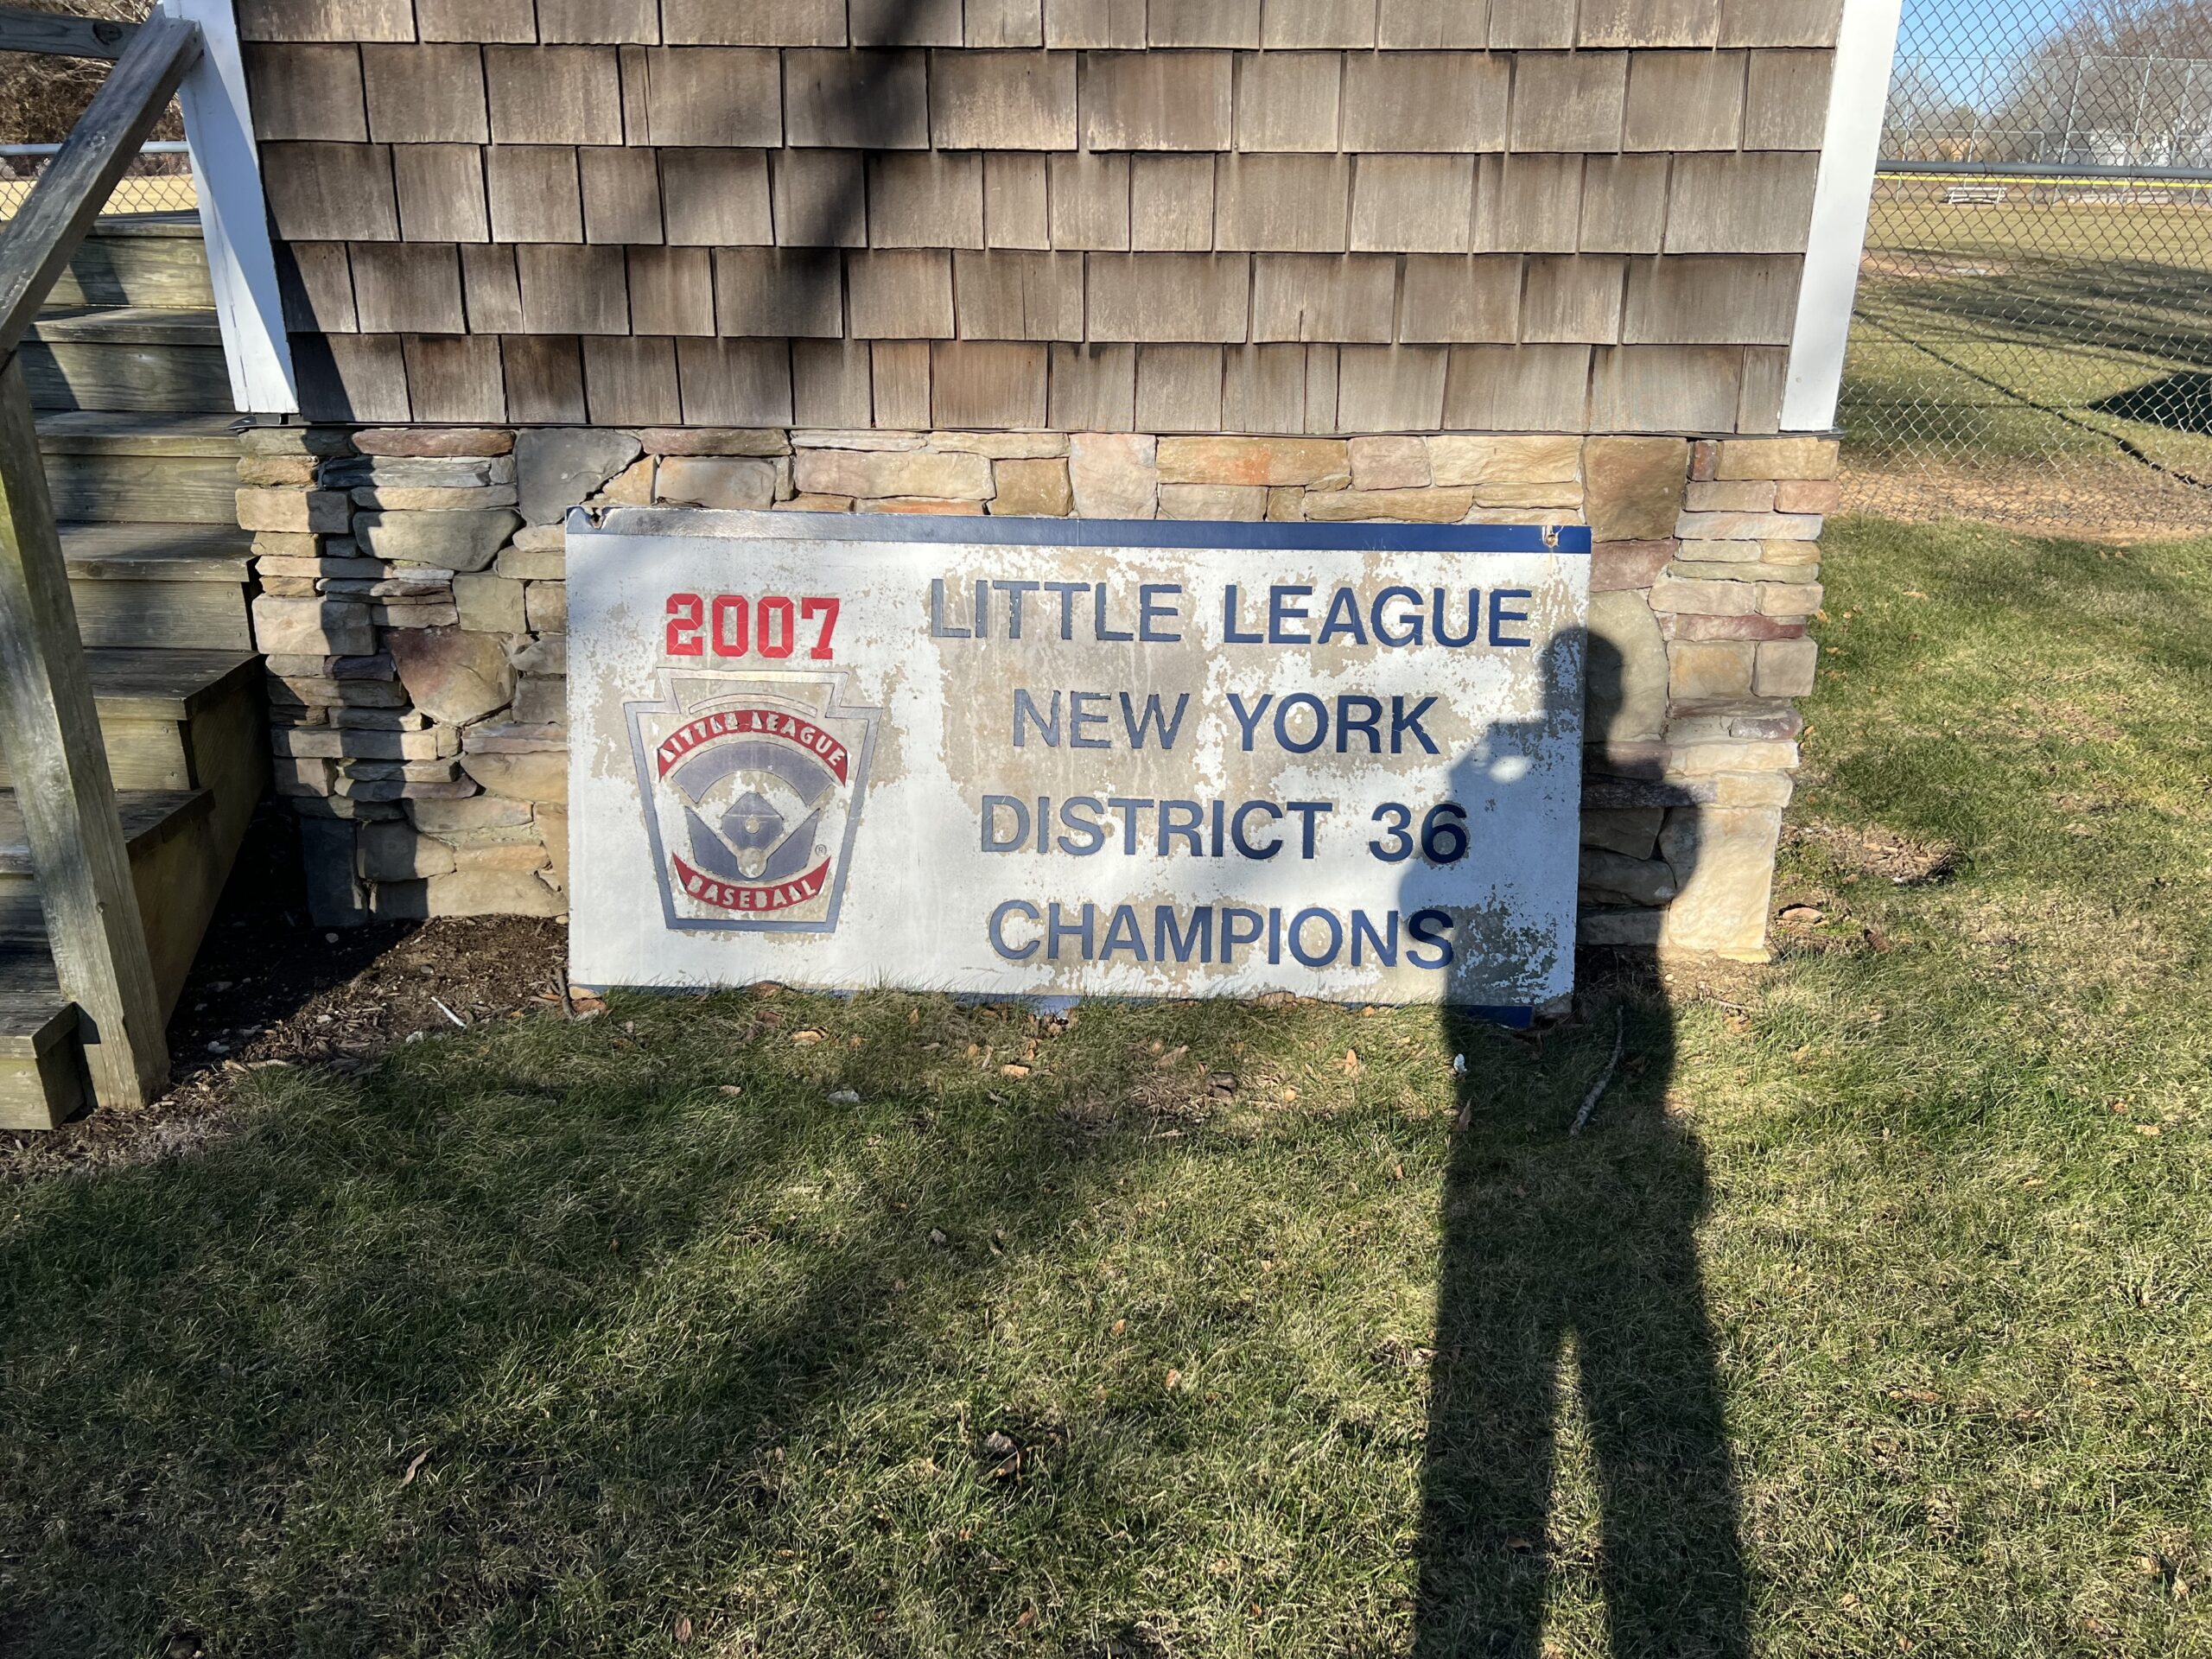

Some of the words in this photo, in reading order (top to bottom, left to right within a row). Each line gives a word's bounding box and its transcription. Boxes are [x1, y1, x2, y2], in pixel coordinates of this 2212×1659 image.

[666, 593, 840, 660] 2007
[930, 578, 1182, 643] LITTLE
[1224, 584, 1532, 647] LEAGUE
[750, 710, 848, 766] LEAGUE
[1013, 688, 1191, 750] NEW
[1226, 693, 1440, 754] YORK
[981, 795, 1332, 861] DISTRICT
[1369, 802, 1470, 864] 36
[688, 874, 817, 909] BASEBALL
[988, 899, 1454, 969] CHAMPIONS
